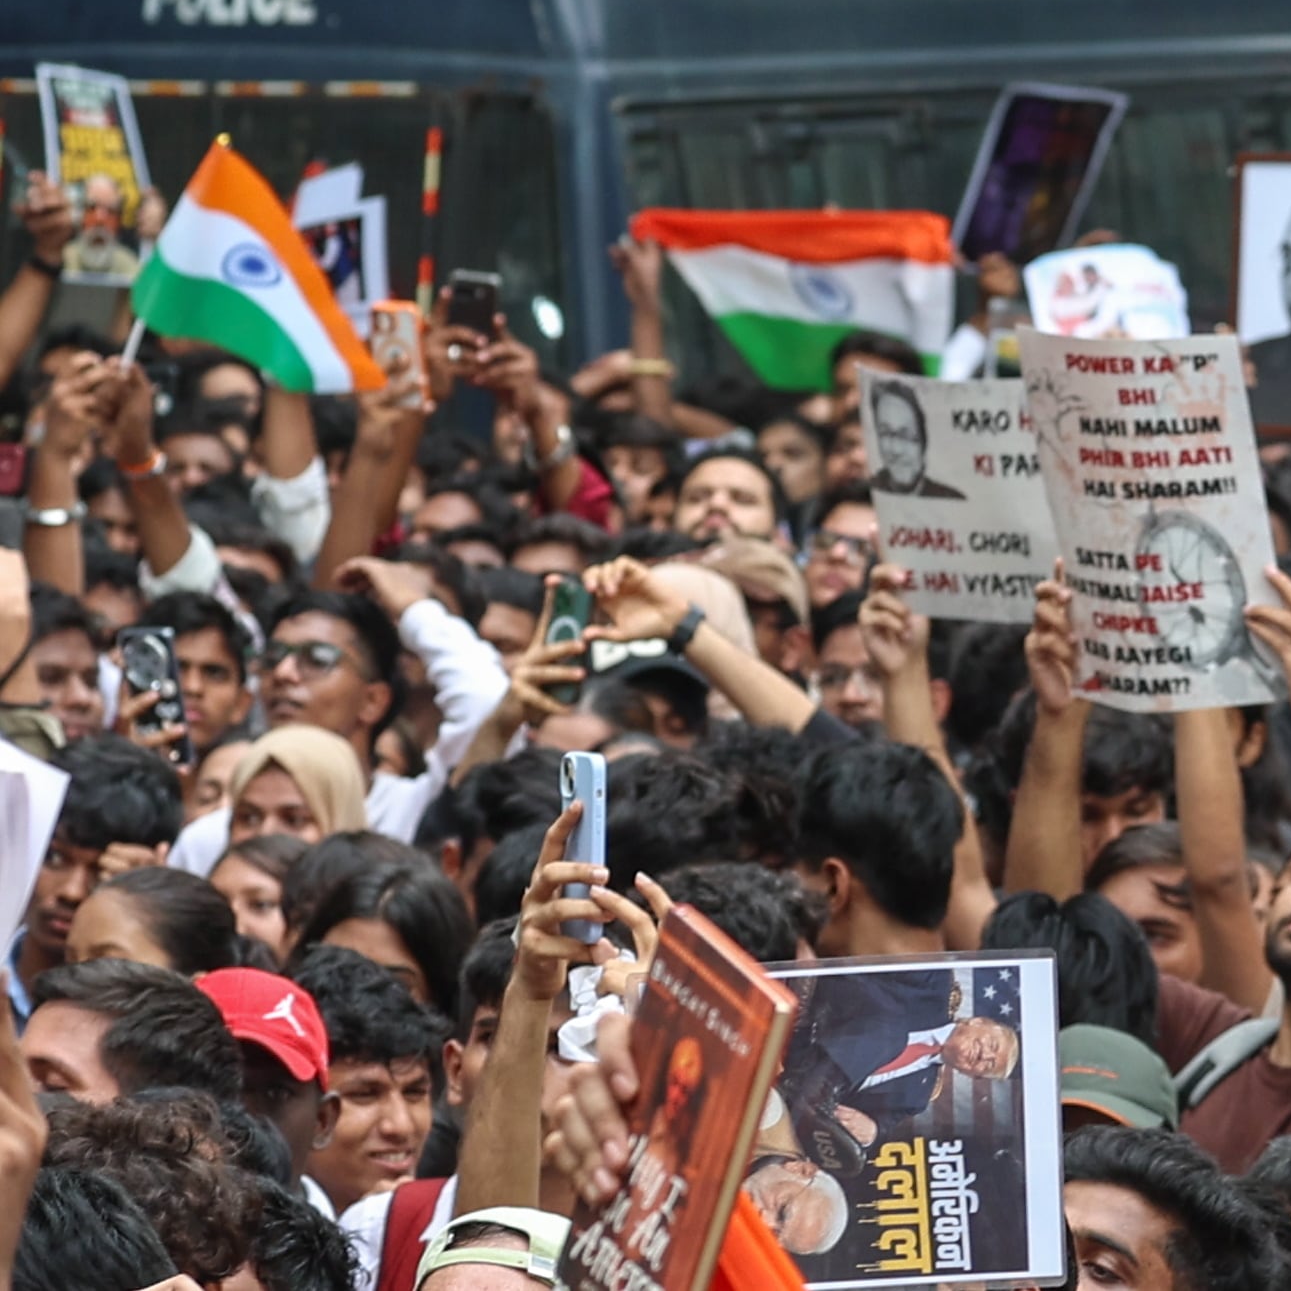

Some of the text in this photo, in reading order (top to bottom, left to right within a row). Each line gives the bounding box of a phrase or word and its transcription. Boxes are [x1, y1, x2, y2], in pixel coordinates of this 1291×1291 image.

[1065, 353, 1135, 374] POWER
[1142, 356, 1174, 374] KA
[1118, 389, 1156, 406] BHI
[952, 409, 1011, 435] KARO
[1080, 416, 1221, 437] NAHI MALUM
[973, 454, 995, 478] KI
[1079, 446, 1232, 468] PHIR BHI AATI
[1084, 479, 1116, 498] HAI
[969, 531, 1030, 558] CHORI
[1076, 548, 1162, 572] SATTA PE
[924, 571, 958, 594] HAI
[1115, 646, 1192, 665] AAYEGI
[811, 1128, 841, 1170] USA
[866, 1137, 933, 1274] दलाल
[929, 1139, 980, 1272] अमेरिकन
